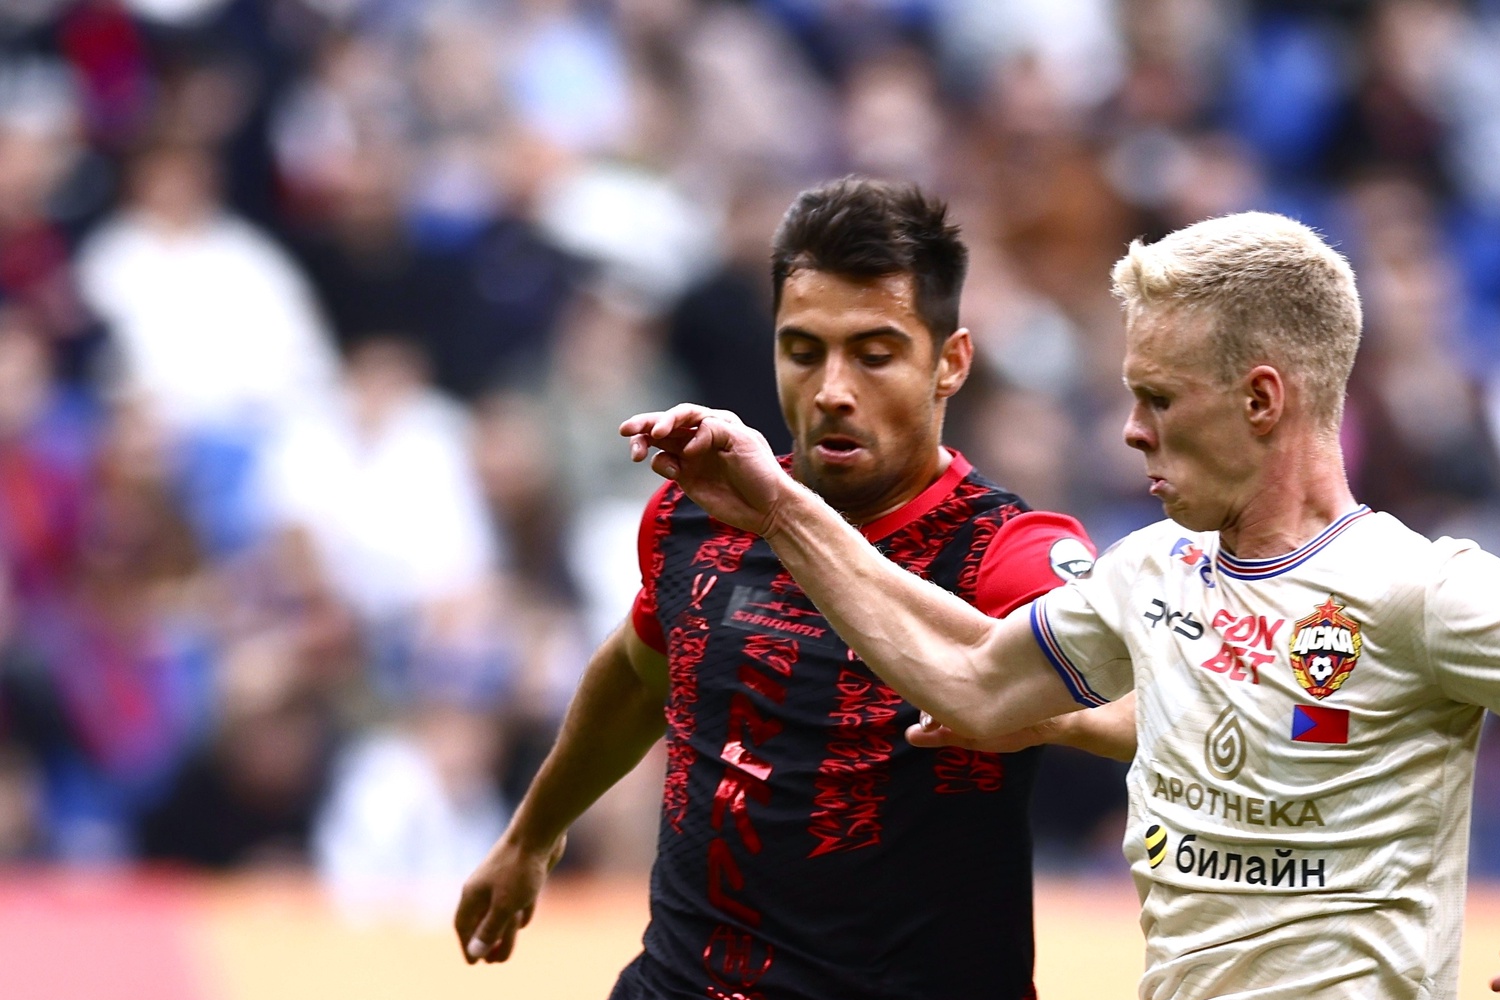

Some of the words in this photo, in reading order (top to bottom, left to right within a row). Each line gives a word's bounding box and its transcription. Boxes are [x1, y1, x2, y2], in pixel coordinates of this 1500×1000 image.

[1212, 608, 1285, 650] FON
[1292, 625, 1355, 655] ЦСКА
[1200, 641, 1276, 685] BET
[1152, 772, 1326, 828] APOTHEKA
[1175, 833, 1326, 888] билайн
